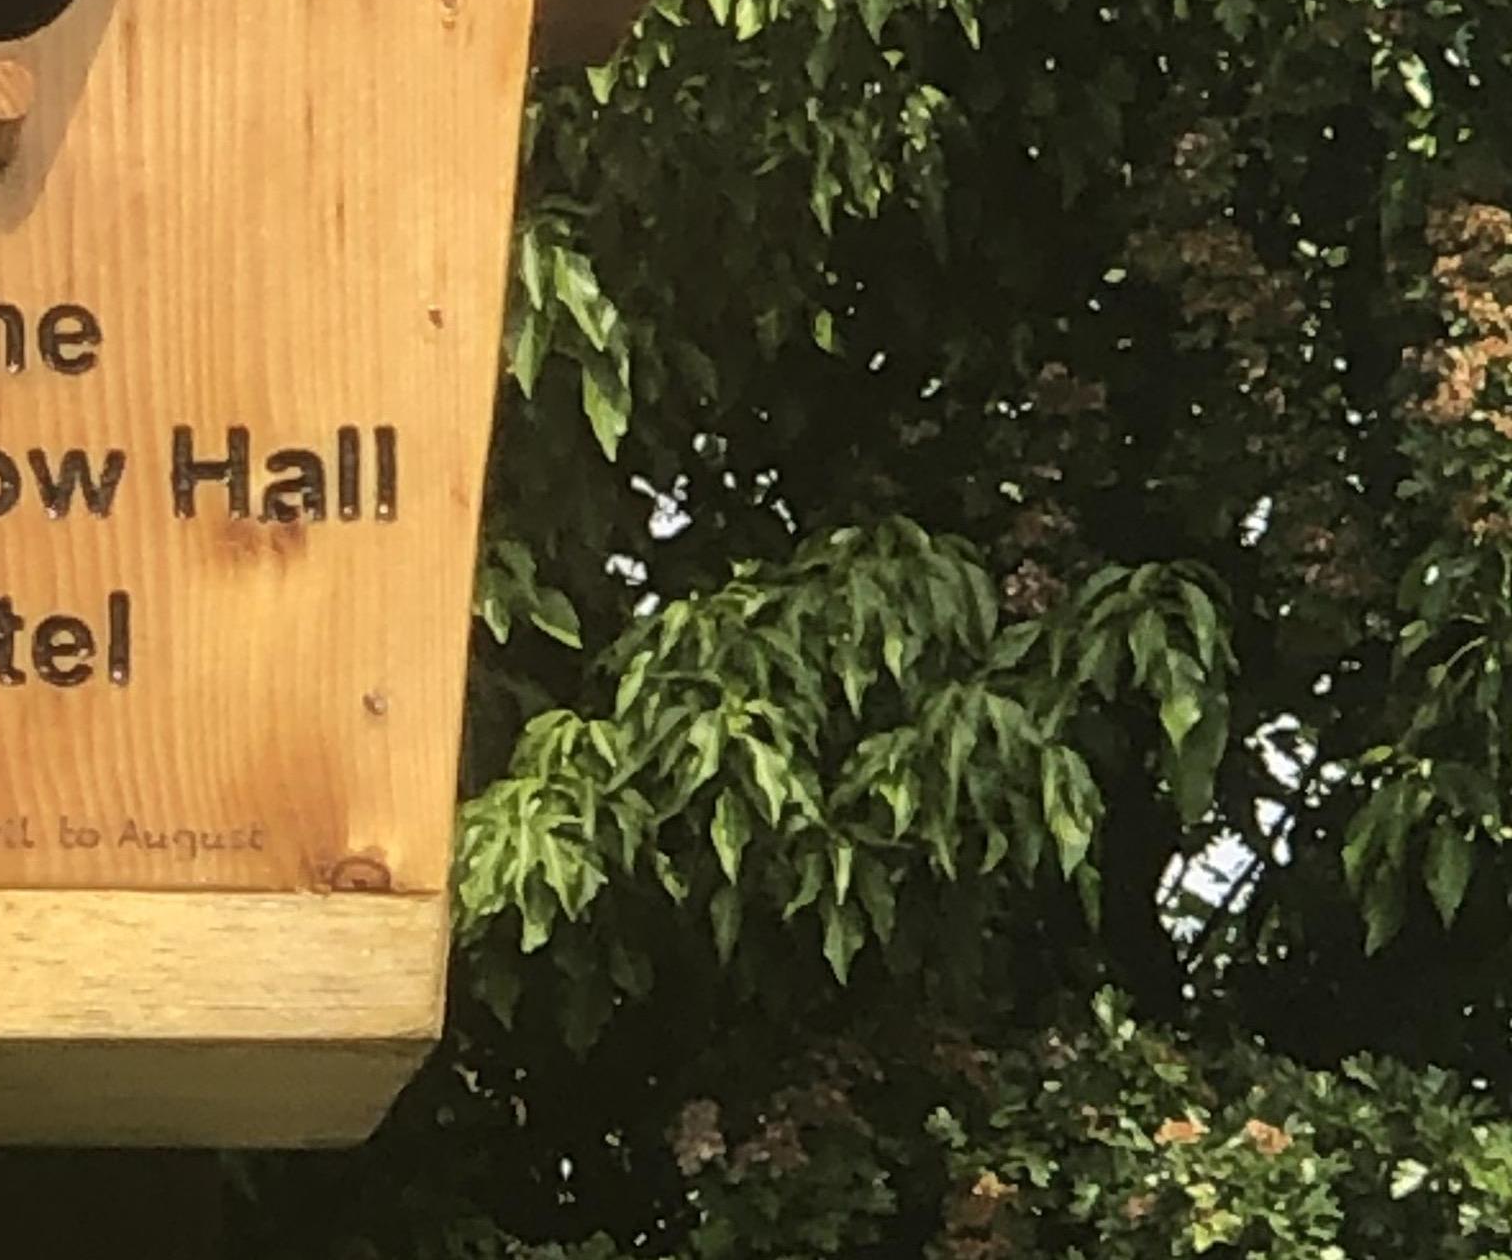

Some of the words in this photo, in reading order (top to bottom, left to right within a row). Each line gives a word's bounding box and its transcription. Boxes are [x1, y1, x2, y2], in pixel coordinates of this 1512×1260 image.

[170, 424, 399, 523] Hall
[59, 815, 101, 850] to
[117, 818, 266, 860] August
